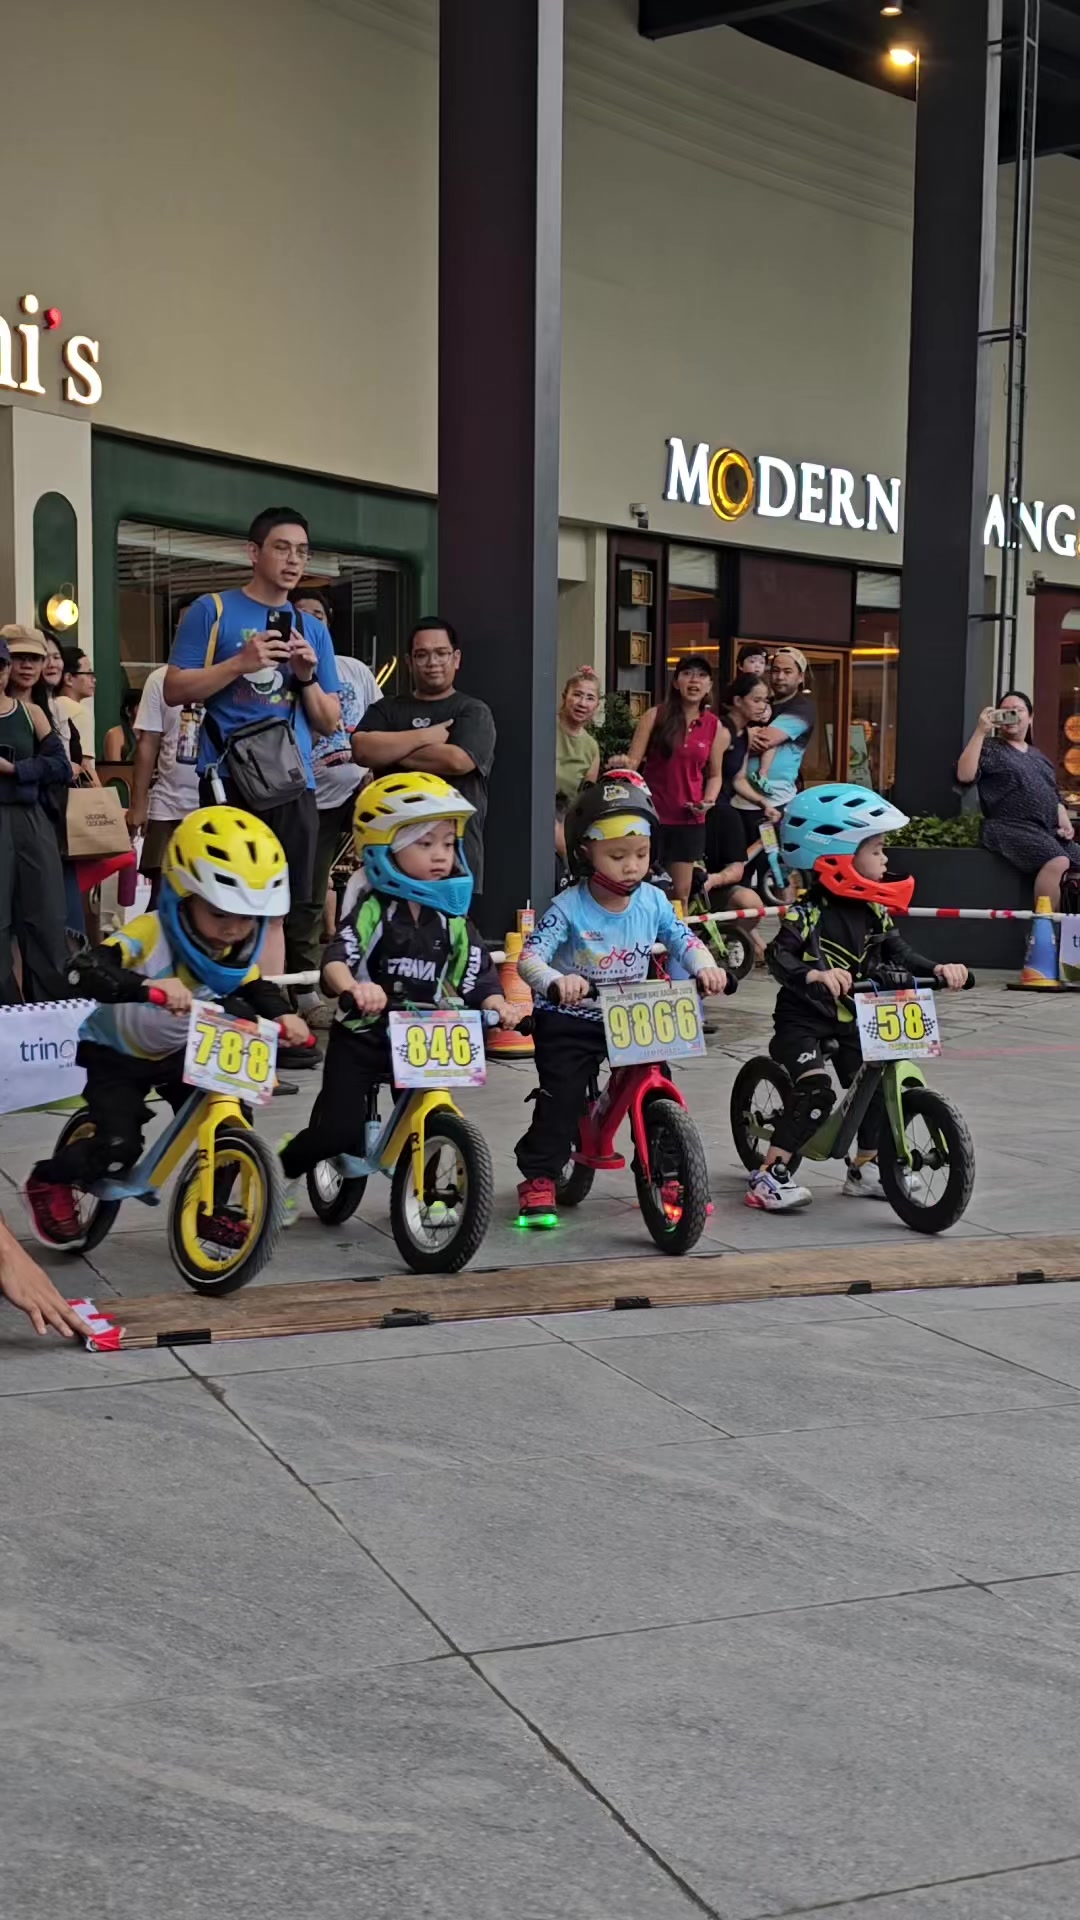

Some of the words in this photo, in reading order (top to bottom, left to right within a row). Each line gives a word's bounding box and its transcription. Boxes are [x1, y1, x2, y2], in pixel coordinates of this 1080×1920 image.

[664, 437, 901, 533] MODERN
[984, 493, 1080, 557] ANG
[609, 998, 697, 1048] 9866
[875, 1001, 926, 1042] 58
[20, 1037, 76, 1062] trino
[194, 1021, 270, 1083] 788
[406, 1024, 472, 1068] 846
